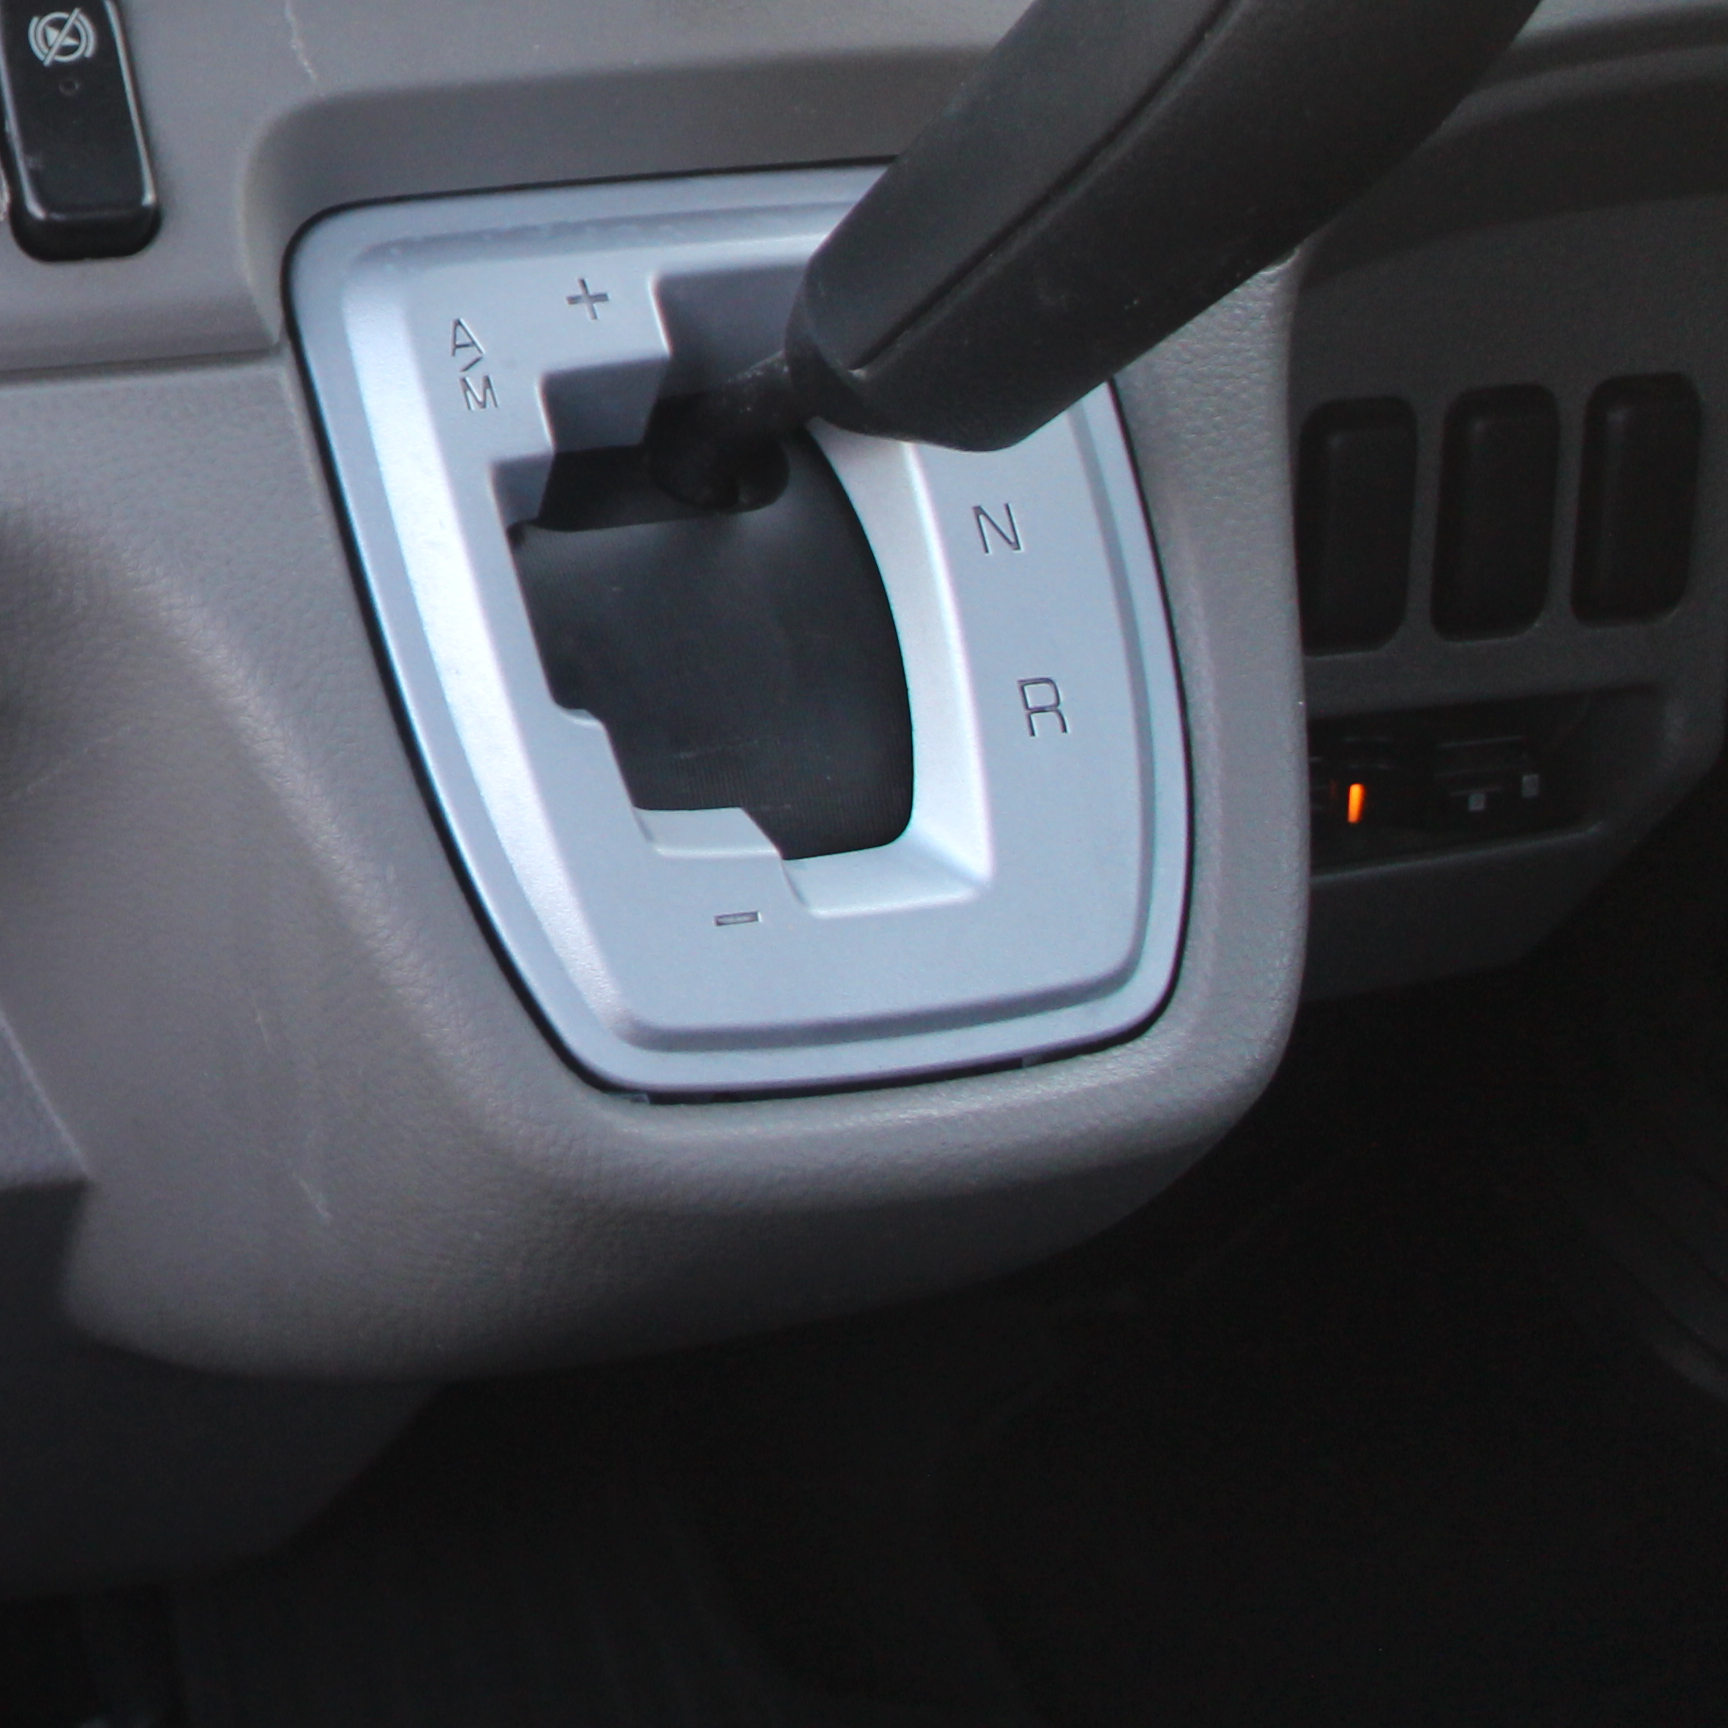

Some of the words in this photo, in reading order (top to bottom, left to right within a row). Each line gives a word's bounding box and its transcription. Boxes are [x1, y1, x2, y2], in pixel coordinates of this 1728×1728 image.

[450, 317, 486, 358] A
[459, 374, 499, 411] M
[972, 502, 1024, 555] N
[1016, 676, 1071, 738] R
